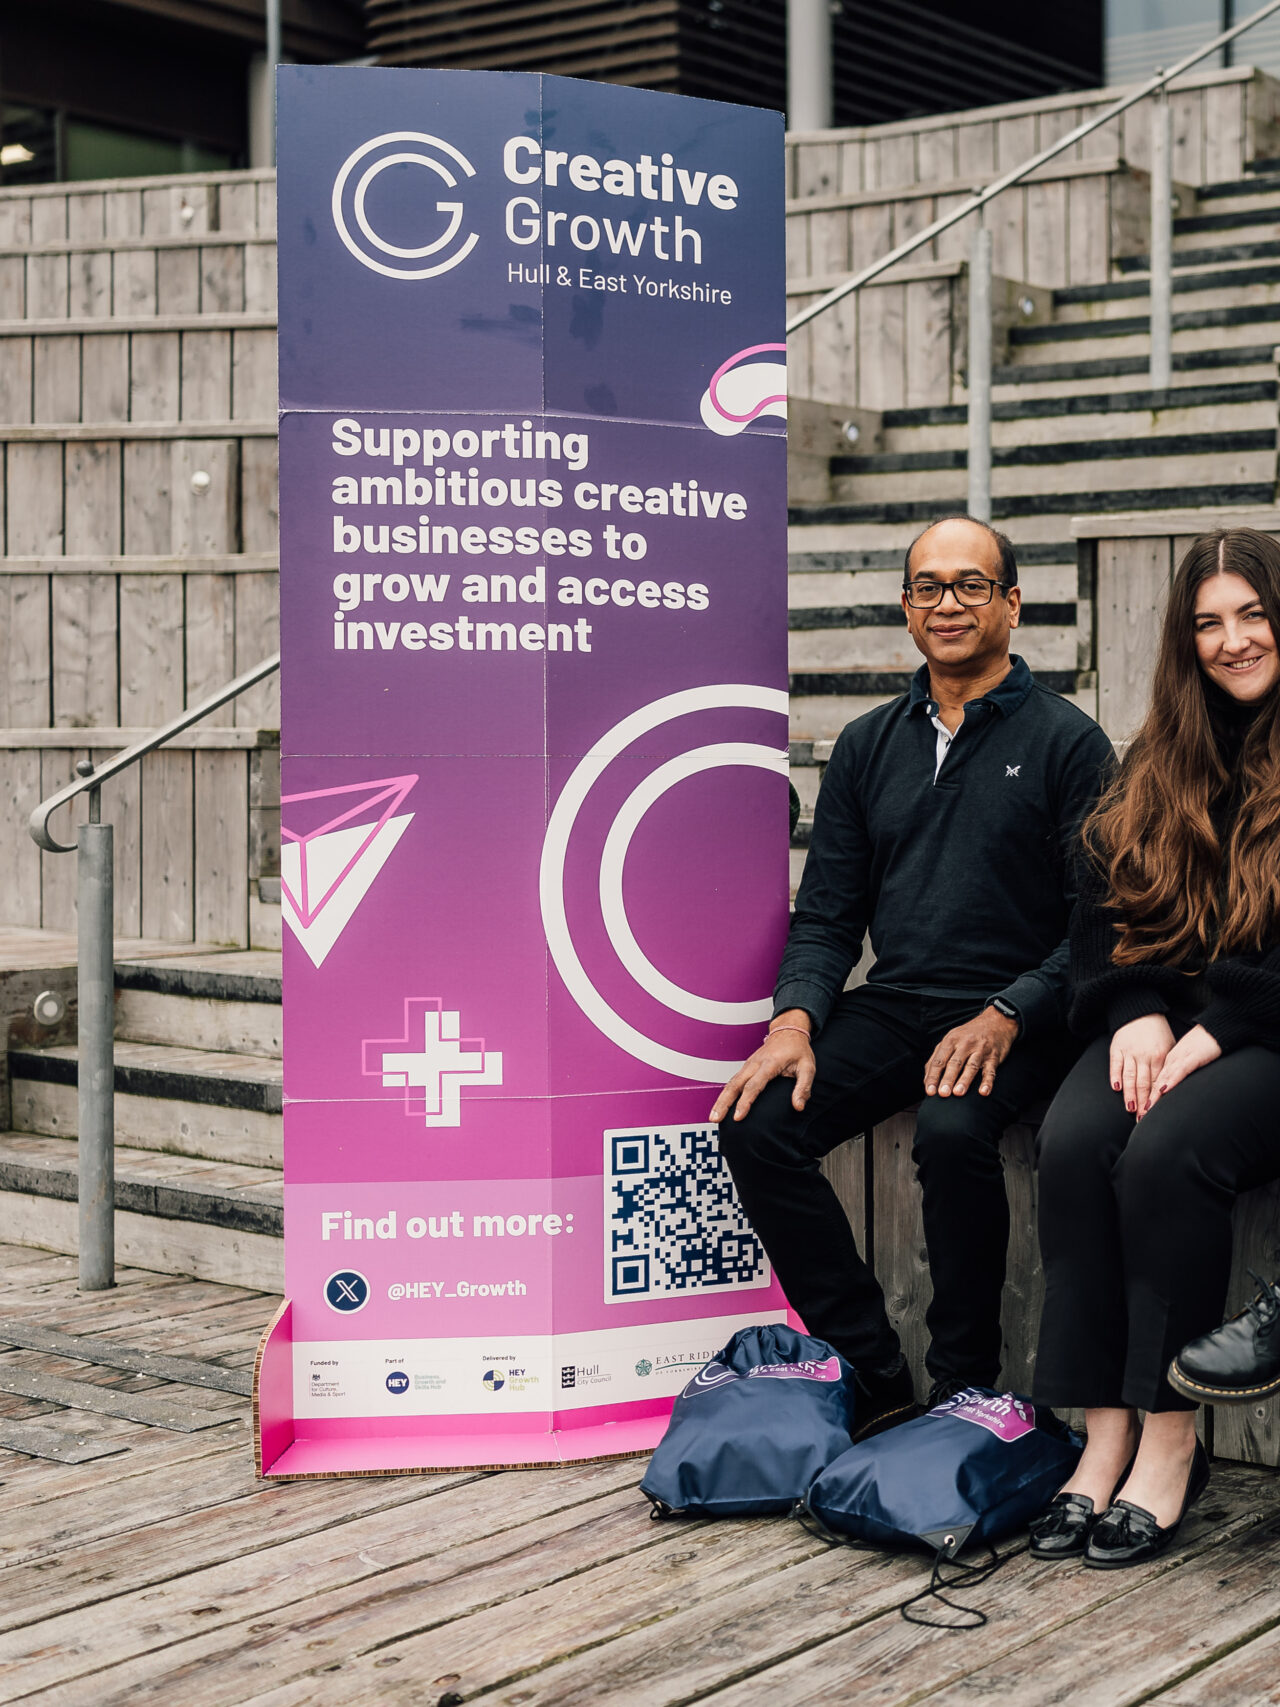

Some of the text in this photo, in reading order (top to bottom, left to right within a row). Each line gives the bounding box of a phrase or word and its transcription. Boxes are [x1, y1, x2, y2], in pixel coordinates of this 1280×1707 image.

[504, 135, 739, 211] Creative
[505, 196, 702, 264] Growth
[508, 263, 732, 305] Hull & East Yorkshire
[332, 419, 590, 471] Supporting
[332, 467, 748, 521] ambitious creative
[333, 515, 647, 560] businesses to
[333, 566, 710, 611] grow and access
[333, 611, 592, 653] investment
[321, 1210, 574, 1241] Find out more:
[387, 1280, 527, 1301] @HEY_Growth
[509, 1368, 525, 1376] HEY
[577, 1364, 599, 1376] Hull
[656, 1353, 684, 1365] EAST
[388, 1378, 408, 1388] HEY
[509, 1376, 539, 1384] Growth
[577, 1376, 612, 1386] City Council
